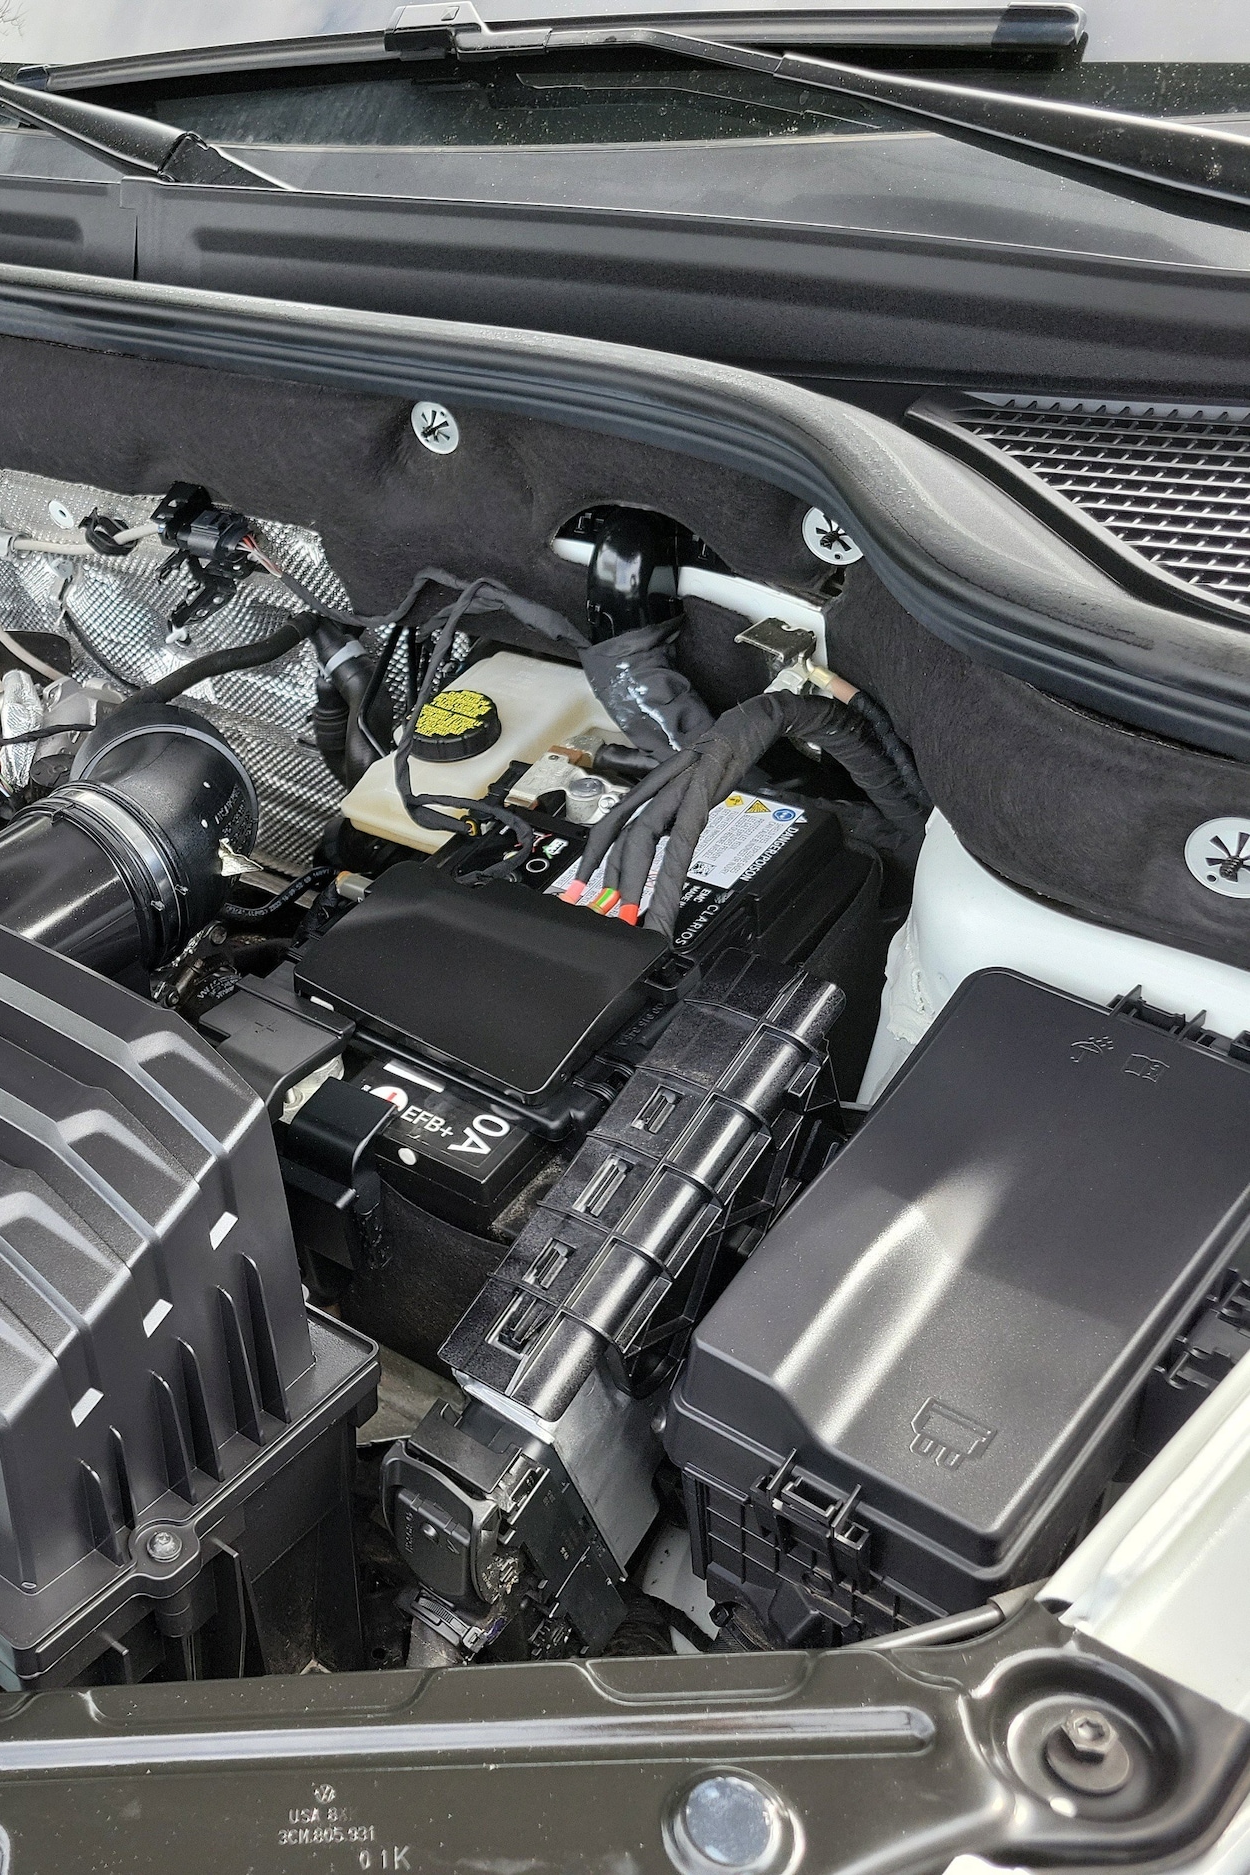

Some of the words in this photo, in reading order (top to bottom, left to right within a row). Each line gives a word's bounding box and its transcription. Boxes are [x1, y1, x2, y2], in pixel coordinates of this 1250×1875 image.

[739, 826, 799, 882] DANGER/POISON
[693, 888, 712, 904] EMC
[675, 904, 719, 947] CLARIOS
[400, 1105, 455, 1138] EFB+
[288, 1807, 321, 1825] USA
